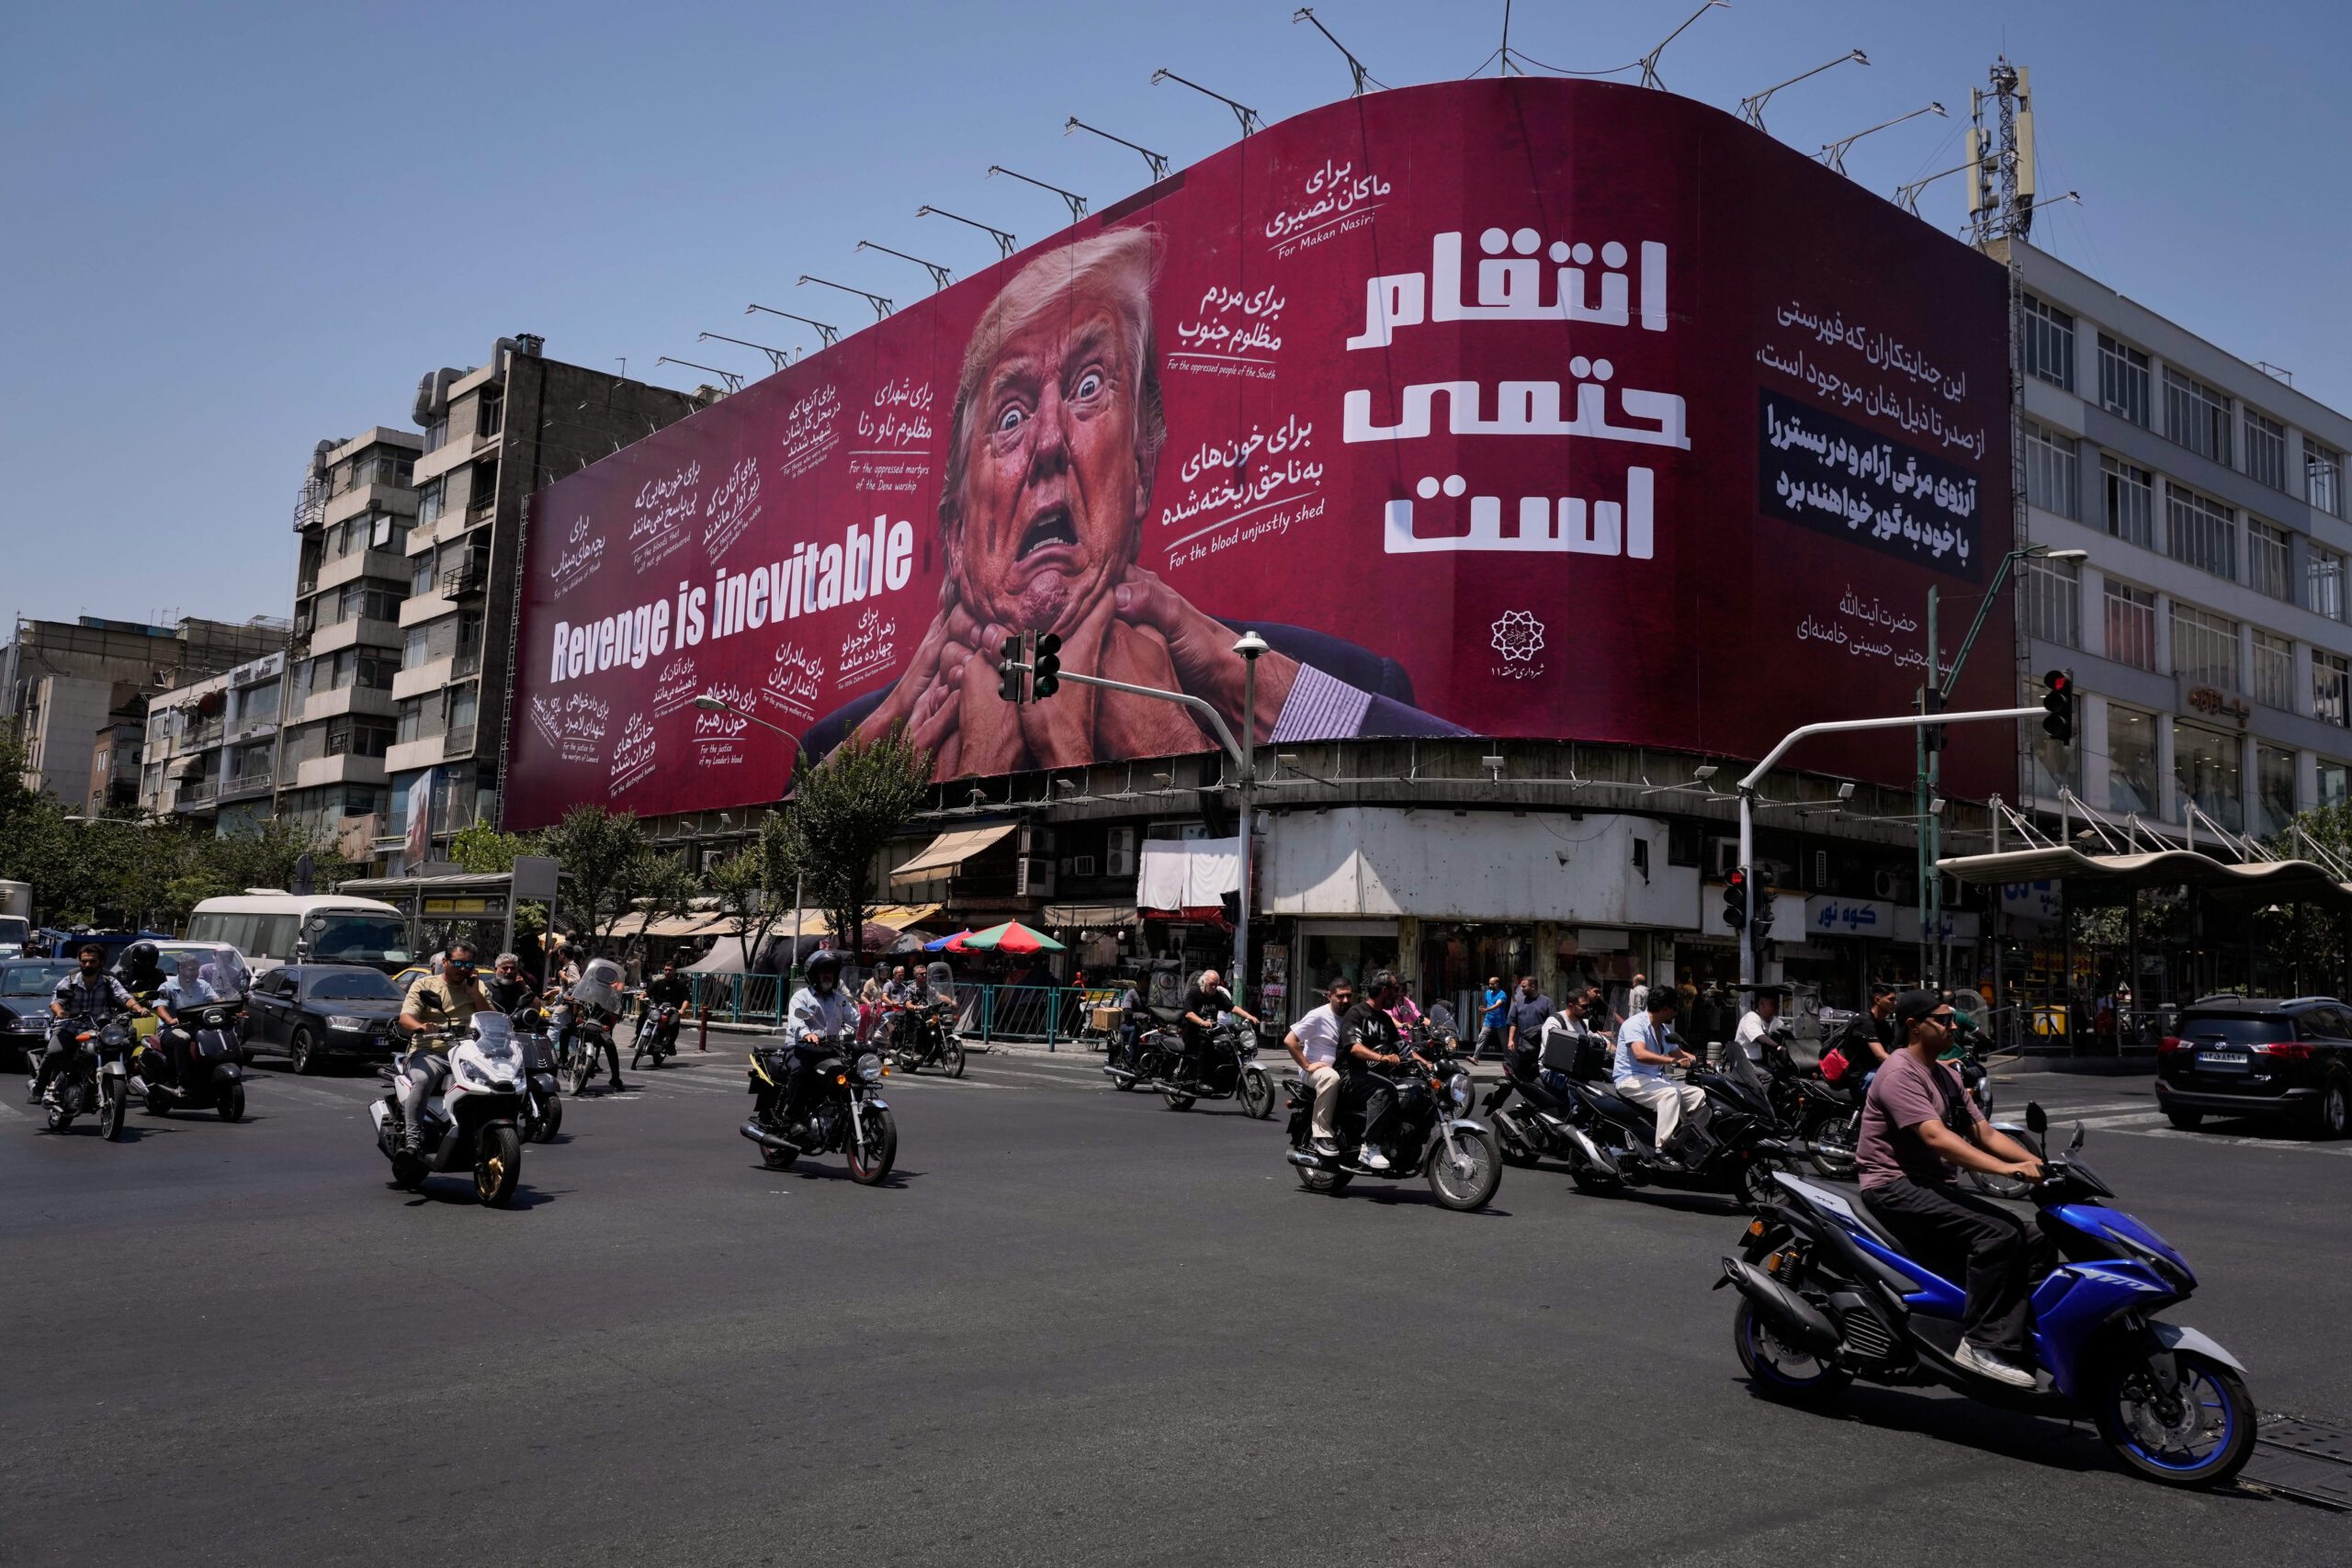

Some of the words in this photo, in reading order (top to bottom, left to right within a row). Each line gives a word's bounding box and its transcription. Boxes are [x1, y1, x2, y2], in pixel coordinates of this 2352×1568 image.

[1306, 159, 1351, 194] برای
[1338, 175, 1391, 211] ماکان
[1265, 191, 1335, 238] نصیری
[1278, 245, 1295, 260] For
[1300, 229, 1336, 250] Makan
[1340, 212, 1375, 233] Nasiri
[1200, 286, 1244, 316] مردم
[1244, 284, 1285, 321] برای
[1346, 227, 1668, 351] انتقام
[1178, 317, 1230, 350] جنوب
[1777, 300, 1844, 345] فهرستی
[1227, 321, 1283, 354] مظلوم
[1846, 326, 1866, 351] که
[1167, 358, 1179, 369] For
[1180, 360, 1190, 370] the
[1190, 362, 1220, 374] oppressed
[1218, 364, 1237, 378] people
[1238, 366, 1245, 377] of
[1245, 367, 1255, 377] the
[1256, 367, 1276, 379] South
[1866, 333, 1941, 393] جنایتکاران
[818, 384, 836, 406] برای
[875, 377, 910, 407] شهدای
[910, 381, 933, 412] برای
[1806, 364, 1863, 407] موجود
[1943, 371, 1966, 403] این
[789, 400, 802, 421] که
[1343, 355, 1691, 451] حتمی
[783, 412, 814, 446] کارشان
[810, 422, 831, 446] شهید
[858, 410, 875, 436] دنا
[875, 412, 896, 444] ناو
[894, 415, 933, 447] مظلوم
[1267, 413, 1313, 455] برای
[1767, 402, 1782, 447] را
[1931, 407, 1942, 435] تا
[787, 434, 809, 458] شدند
[1780, 415, 1827, 465] بستر
[1941, 425, 1974, 448] صدر
[1974, 428, 1984, 460] از
[1825, 437, 1848, 468] در
[1848, 445, 1860, 477] و
[1860, 444, 1893, 486] آرام
[684, 458, 701, 486] برای
[741, 457, 756, 482] برای
[849, 460, 862, 474] For
[863, 462, 873, 474] the
[874, 462, 905, 478] oppressed
[905, 463, 930, 479] martyrs
[1892, 457, 1933, 500] مرگی
[635, 480, 651, 509] که
[707, 486, 719, 517] که
[748, 473, 760, 502] زیر
[855, 478, 865, 491] of
[865, 478, 876, 491] the
[877, 479, 893, 491] Dena
[894, 479, 917, 496] warship
[1776, 469, 1806, 513] برد
[1934, 477, 1976, 517] آرزوی
[1385, 466, 1655, 560] است
[1806, 481, 1874, 530] خواهند
[570, 514, 590, 544] برای
[1170, 552, 1186, 570] For
[1190, 544, 1206, 561] the
[1211, 527, 1238, 553] blood
[1241, 512, 1290, 542] unjustly
[1295, 498, 1325, 524] shed
[1871, 502, 1904, 542] گور
[1903, 513, 1921, 551] به
[1921, 521, 1955, 558] خود
[1956, 526, 1970, 568] با
[551, 550, 576, 583] میناب
[634, 553, 642, 566] For
[550, 599, 670, 684] Revenge
[675, 581, 707, 649] is
[711, 513, 913, 639] inevitable
[858, 606, 879, 630] برای
[876, 616, 896, 642] زهرا
[1880, 610, 1918, 634] حضرت
[775, 640, 806, 668] مادران
[841, 626, 876, 658] کوچولو
[865, 642, 894, 662] چهارده
[1849, 636, 1893, 658] حسینی
[659, 663, 670, 682] که
[682, 657, 695, 675] برای
[806, 656, 825, 682] برای
[840, 653, 863, 671] ماهه
[1515, 662, 1544, 680] شهرداری
[692, 674, 697, 686] تا
[768, 667, 794, 692] ایران
[789, 675, 818, 701] داغدار
[566, 691, 597, 714] دادخواهی
[597, 700, 609, 721] برای
[740, 688, 757, 713] برای
[582, 723, 605, 739] شهدای
[625, 712, 643, 735] برای
[695, 713, 724, 735] رهبرم
[630, 740, 656, 766] ویران
[698, 755, 705, 767] of
[705, 759, 712, 768] my
[712, 755, 730, 765] Leader's
[730, 753, 743, 763] blood
[700, 744, 708, 754] For
[709, 744, 718, 753] the
[718, 743, 732, 756] justice
[1818, 900, 1838, 928] نور
[1843, 903, 1875, 931] کوه
